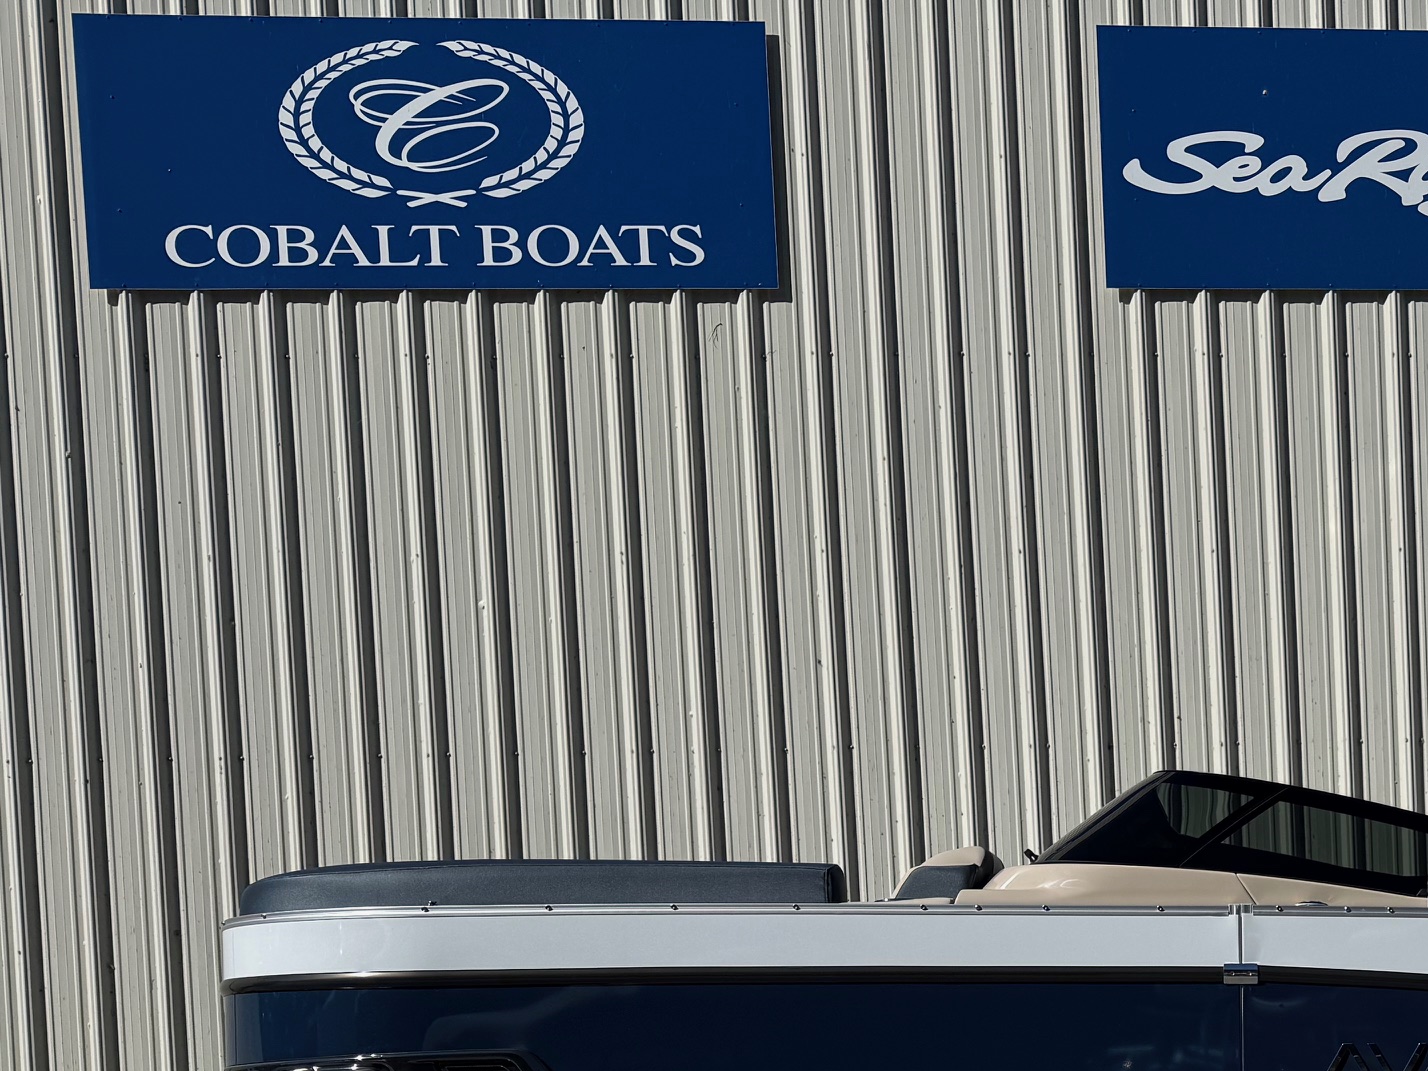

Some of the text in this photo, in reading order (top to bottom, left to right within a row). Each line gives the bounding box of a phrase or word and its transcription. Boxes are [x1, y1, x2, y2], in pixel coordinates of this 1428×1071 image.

[1122, 130, 1331, 203] Sea
[164, 224, 705, 268] COBALT BOATS
